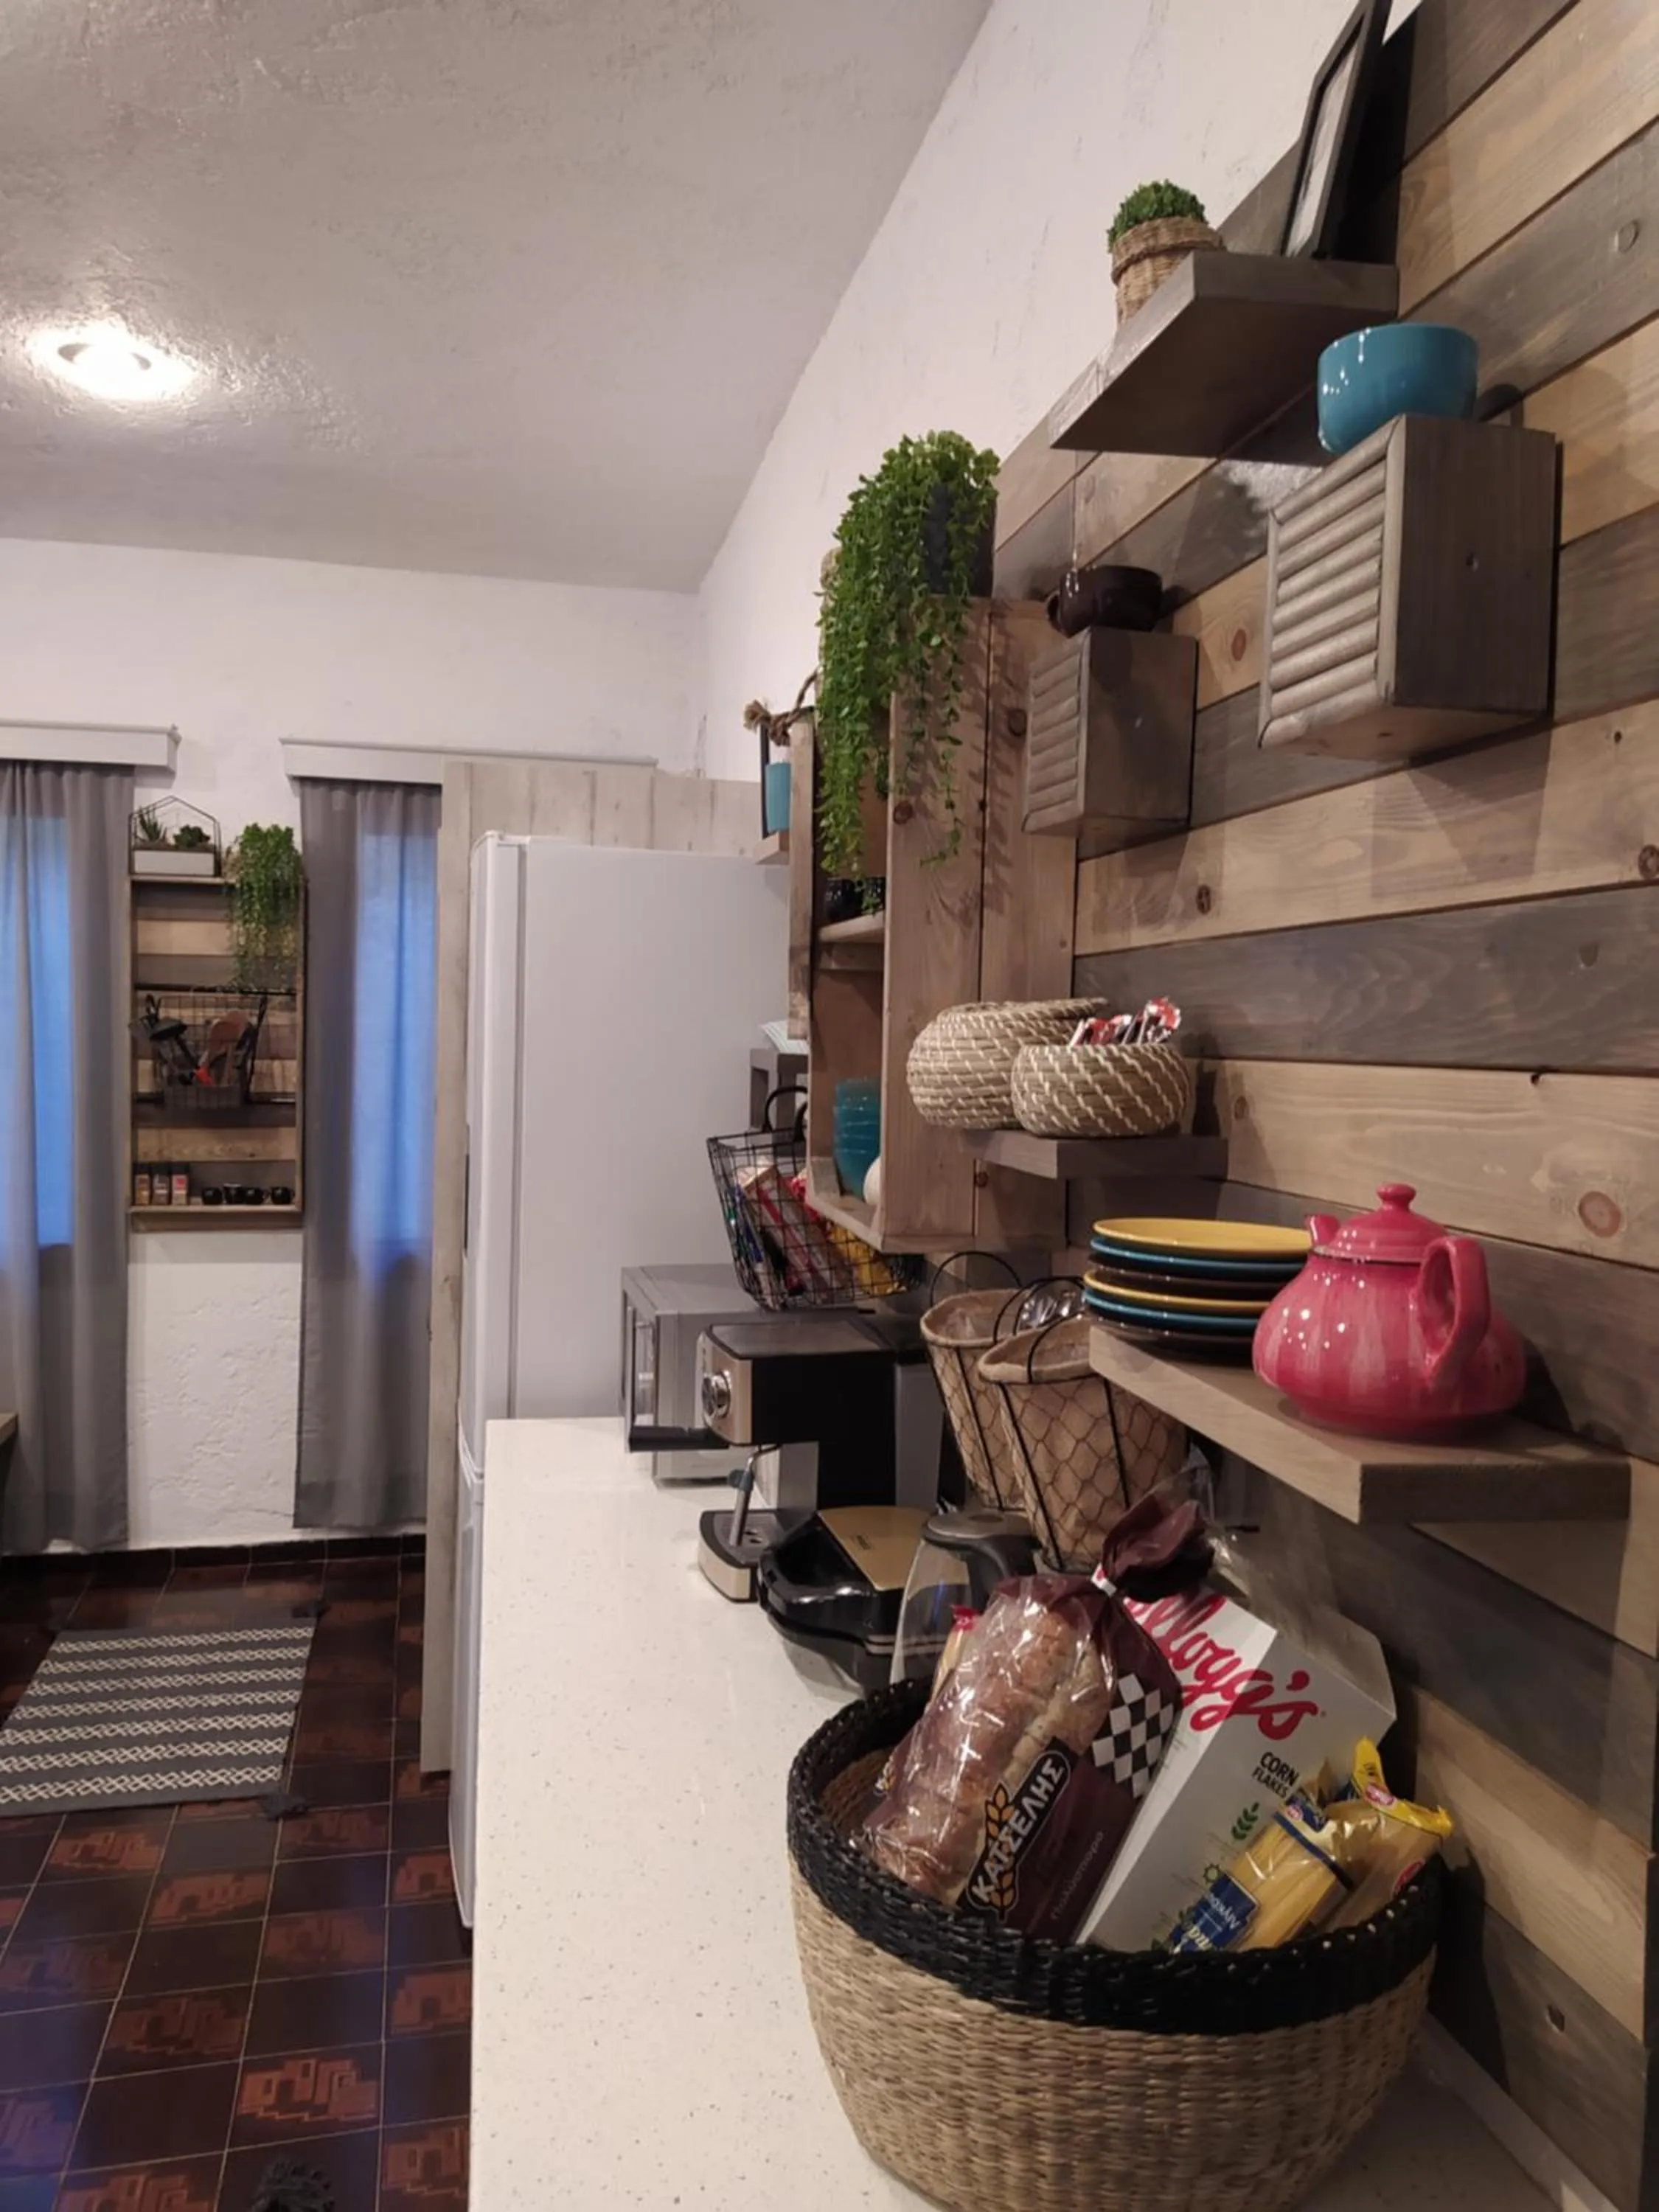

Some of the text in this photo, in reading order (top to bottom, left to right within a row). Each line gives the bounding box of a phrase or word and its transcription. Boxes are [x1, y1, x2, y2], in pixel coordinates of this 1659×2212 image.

[1123, 1593, 1318, 1740] llogg's
[1252, 1767, 1290, 1799] FLAKES
[1259, 1751, 1300, 1787] CORN
[971, 1758, 1064, 1903] ΚΑΤΣΕΛΗΣ
